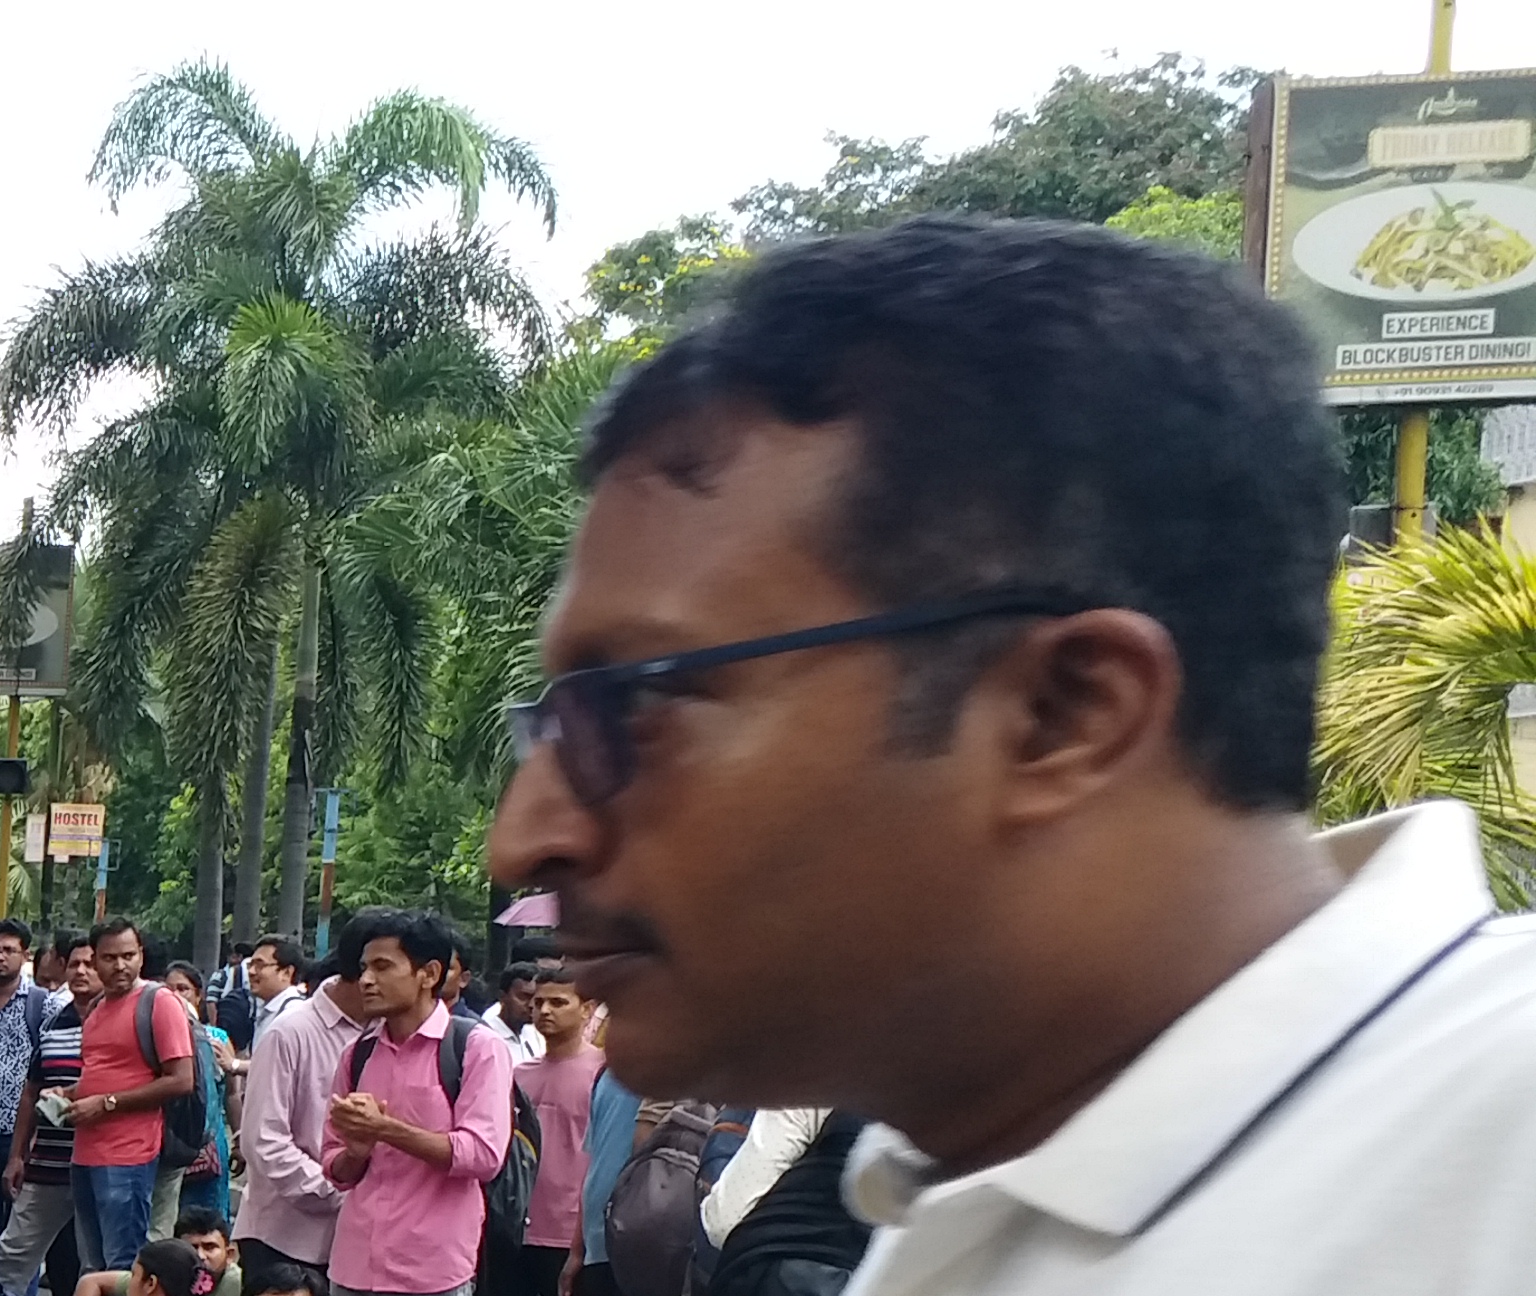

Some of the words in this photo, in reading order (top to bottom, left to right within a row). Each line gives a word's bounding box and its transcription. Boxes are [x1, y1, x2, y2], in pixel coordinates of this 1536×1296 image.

[1385, 314, 1491, 335] EXPERIENCE
[1341, 347, 1464, 366] BLOCKBUSTER
[1469, 342, 1531, 360] DINING!
[54, 812, 100, 826] HOSTEL
